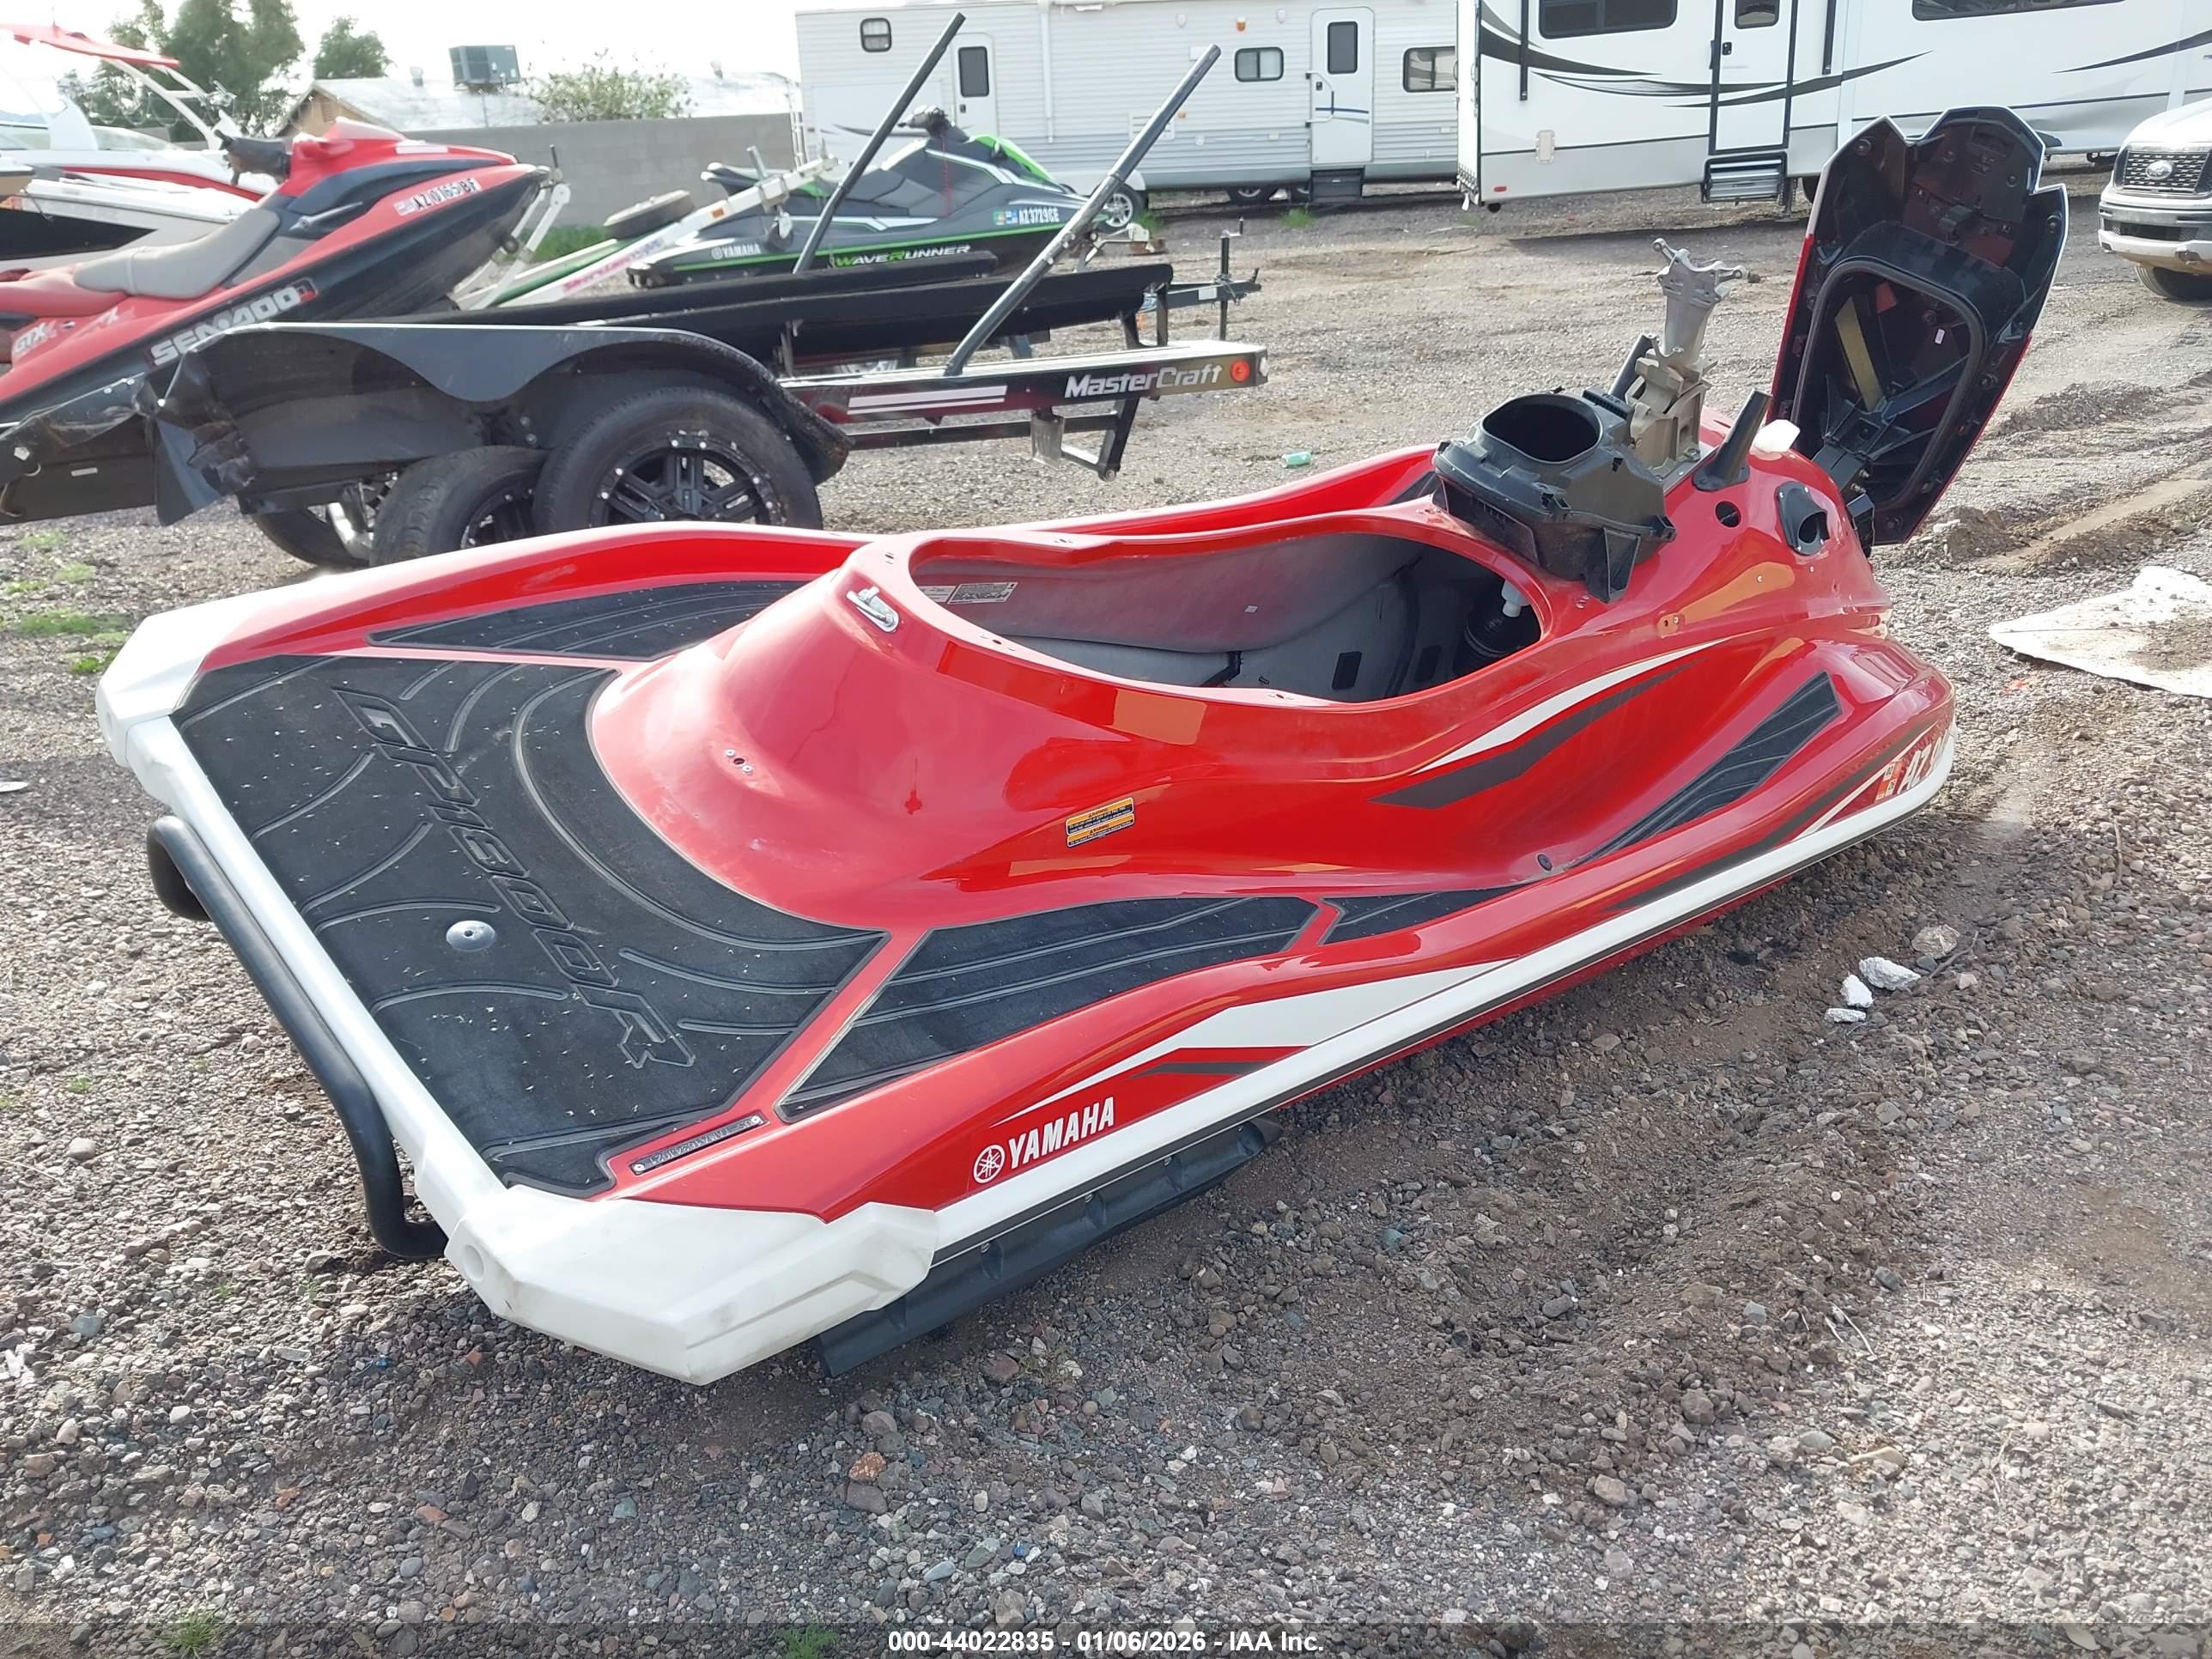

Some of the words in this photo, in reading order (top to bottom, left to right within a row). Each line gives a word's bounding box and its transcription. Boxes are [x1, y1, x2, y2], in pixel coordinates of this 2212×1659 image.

[722, 242, 763, 258] YAMAHA
[836, 244, 971, 268] WAVERUNNER
[1064, 363, 1223, 398] MasterCraft
[1008, 1096, 1115, 1170] YAMAHA
